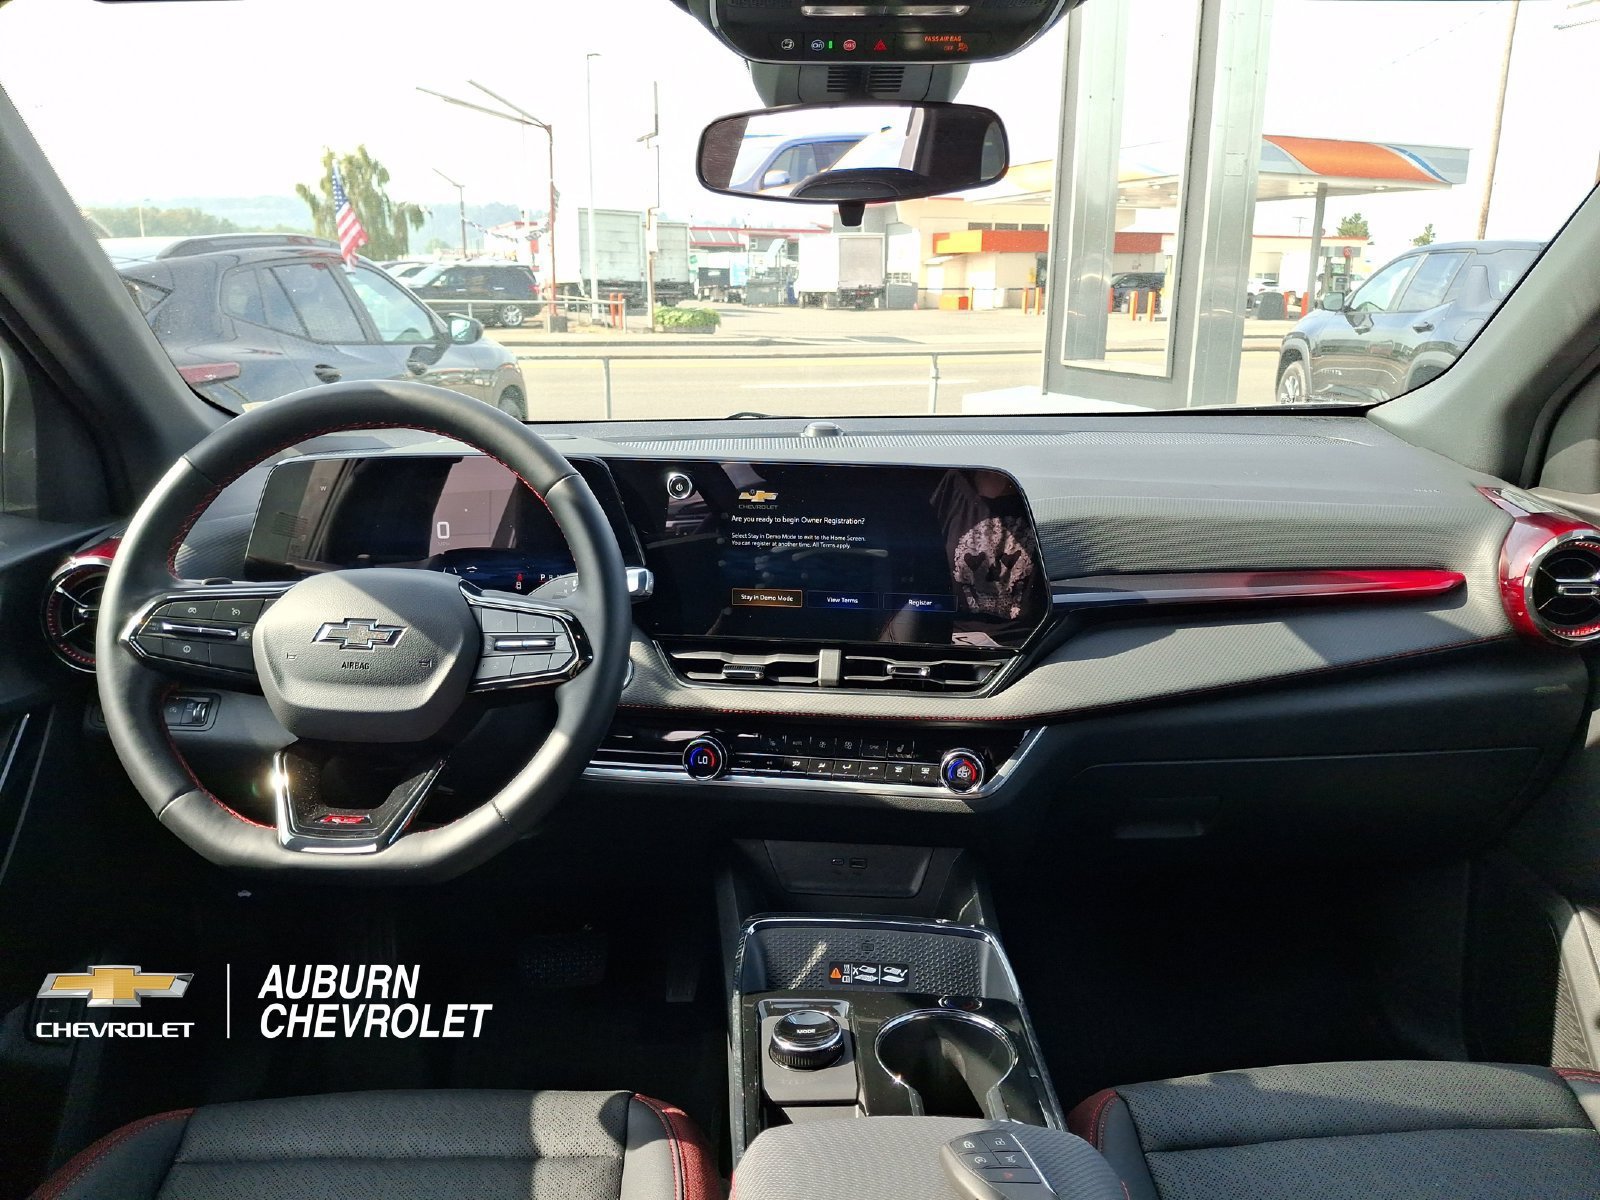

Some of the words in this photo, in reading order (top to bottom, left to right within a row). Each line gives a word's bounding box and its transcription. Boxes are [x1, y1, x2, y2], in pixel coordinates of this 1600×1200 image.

[731, 514, 742, 522] Are
[756, 516, 773, 524] ready
[782, 516, 800, 524] begin
[824, 517, 866, 526] Registration?
[436, 522, 450, 538] 0
[908, 599, 932, 607] Register
[342, 661, 370, 670] AIRBAG
